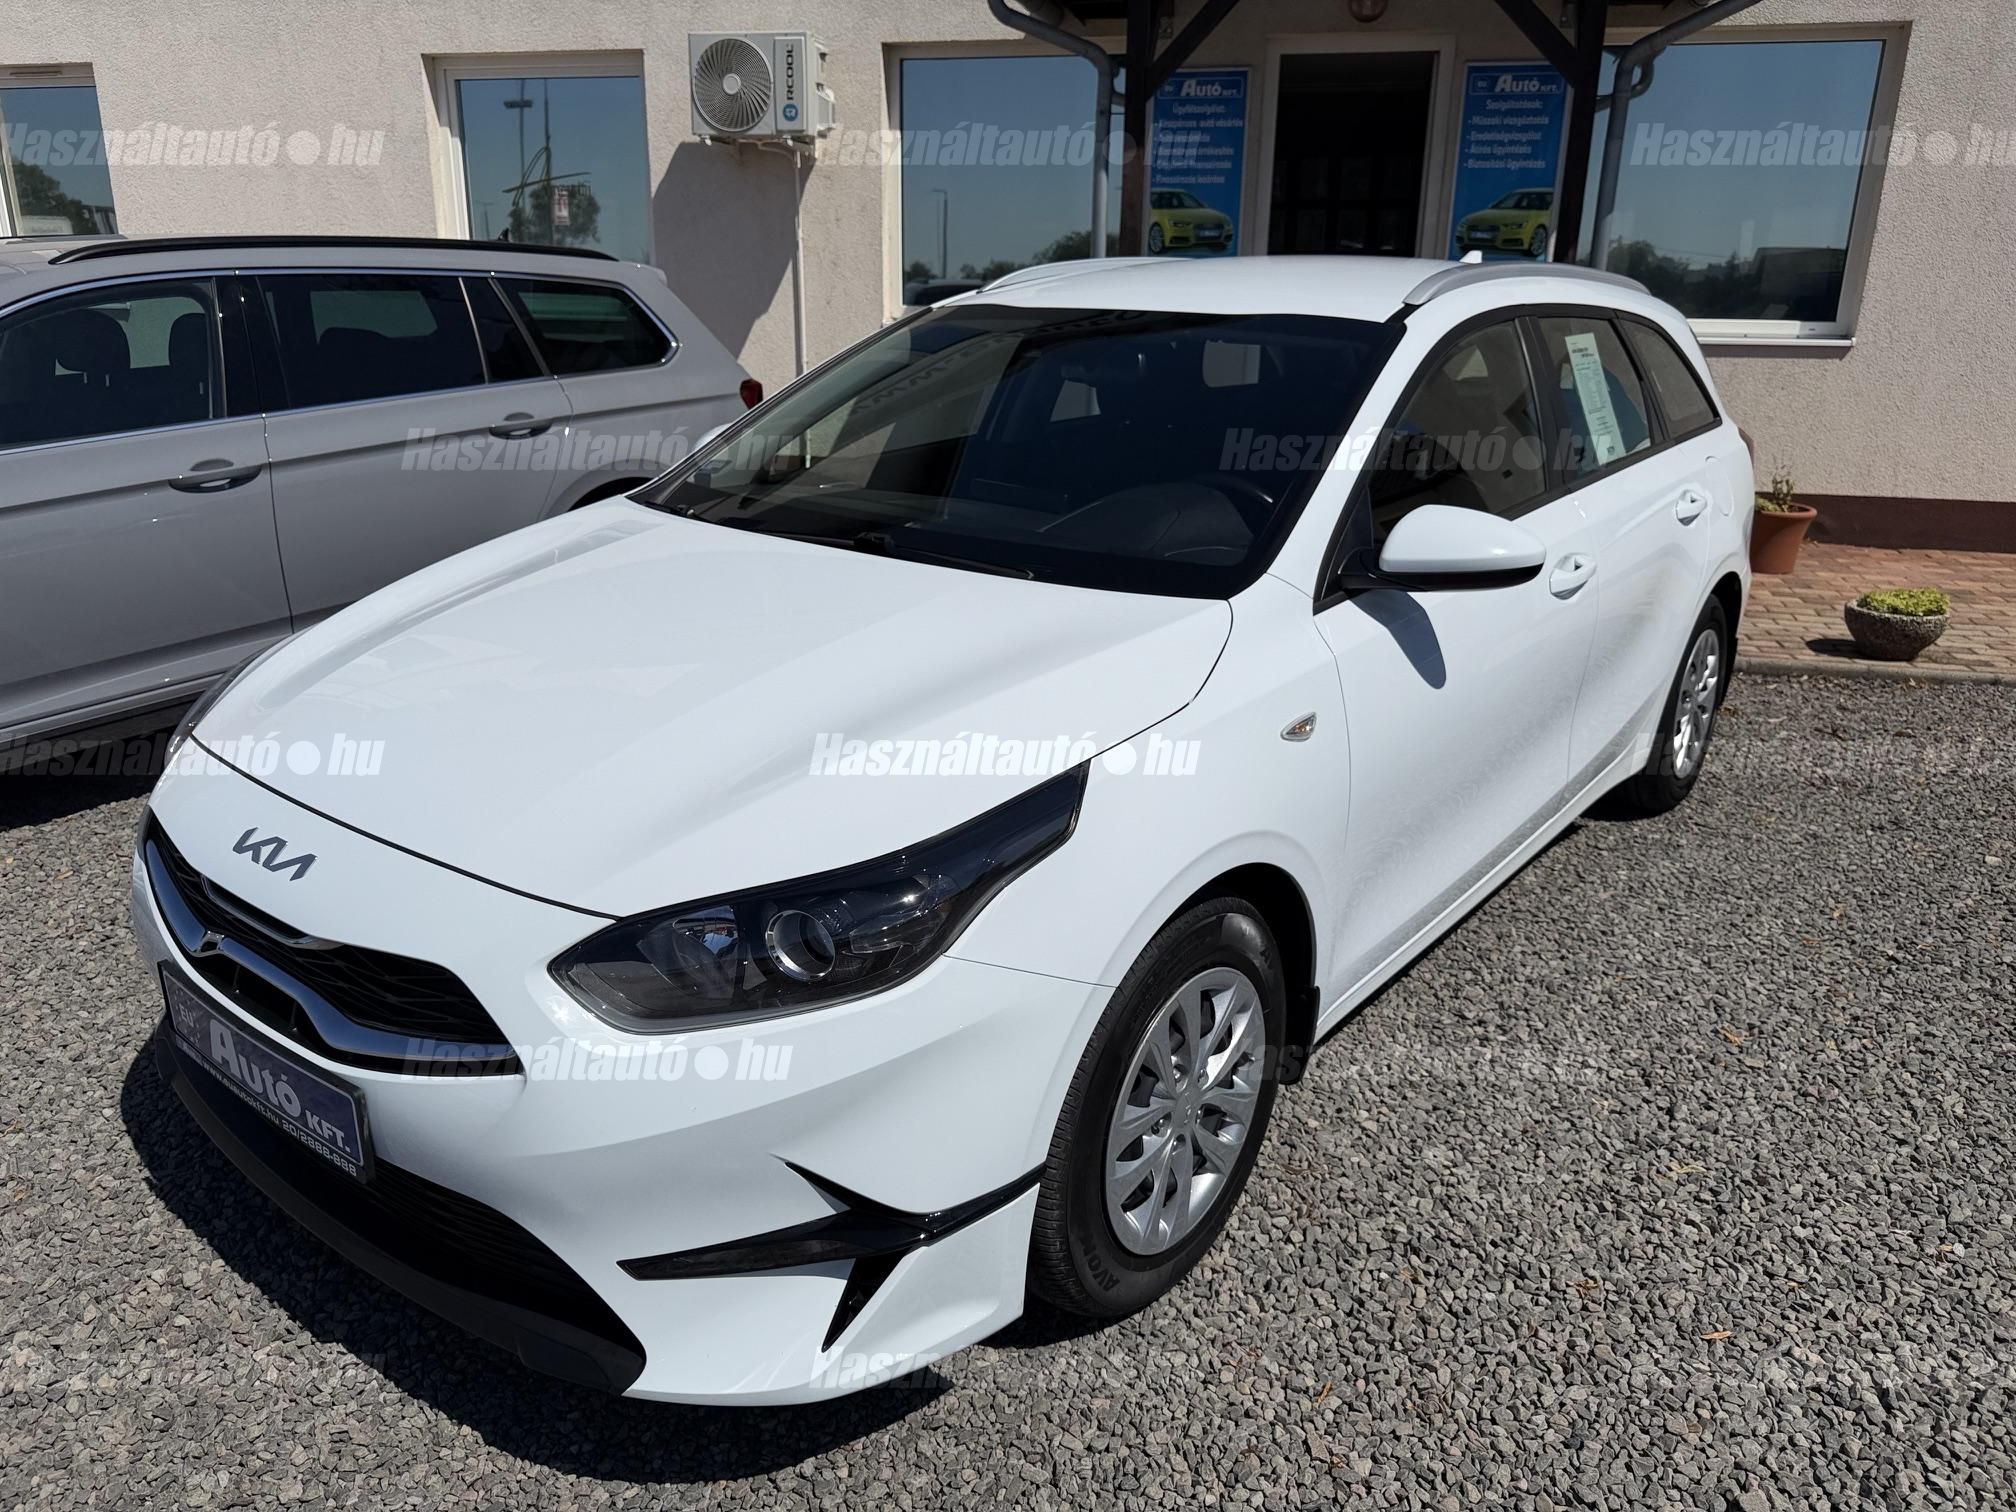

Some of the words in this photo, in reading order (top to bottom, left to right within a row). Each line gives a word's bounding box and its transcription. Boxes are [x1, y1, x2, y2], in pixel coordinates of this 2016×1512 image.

[786, 43, 794, 101] RCOOL
[1180, 79, 1222, 97] Autó
[1494, 74, 1540, 93] Autó
[232, 826, 318, 882] KIA
[209, 1018, 302, 1118] Autó
[304, 1109, 351, 1153] KFT.
